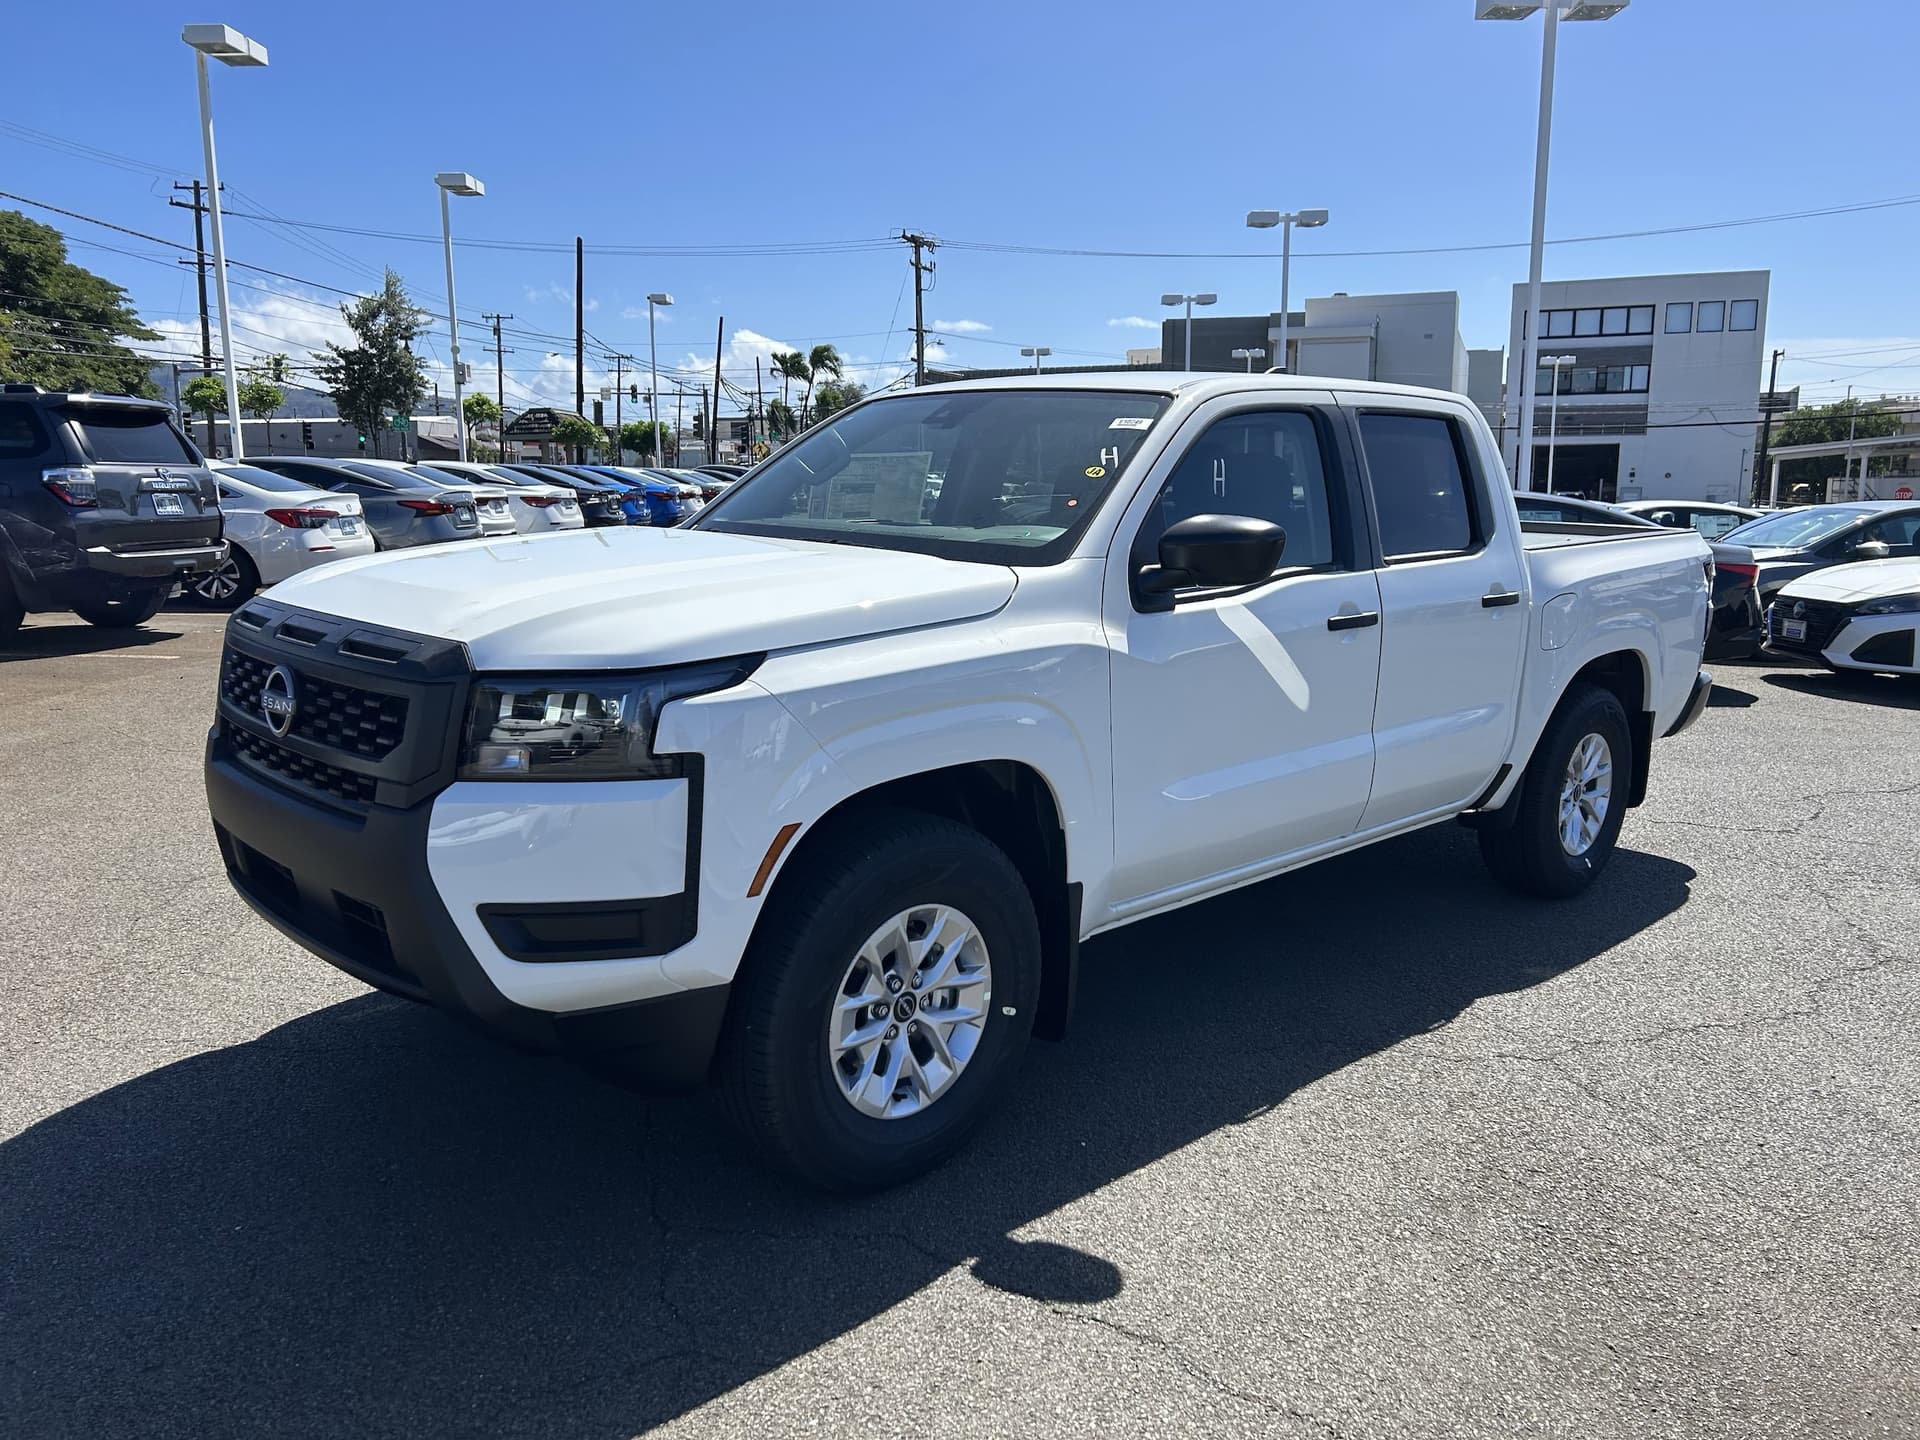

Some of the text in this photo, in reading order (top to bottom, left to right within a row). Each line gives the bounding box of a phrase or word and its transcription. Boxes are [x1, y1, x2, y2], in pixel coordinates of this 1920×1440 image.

[1100, 446, 1118, 469] H
[1213, 458, 1225, 497] H
[1895, 490, 1912, 499] STOP
